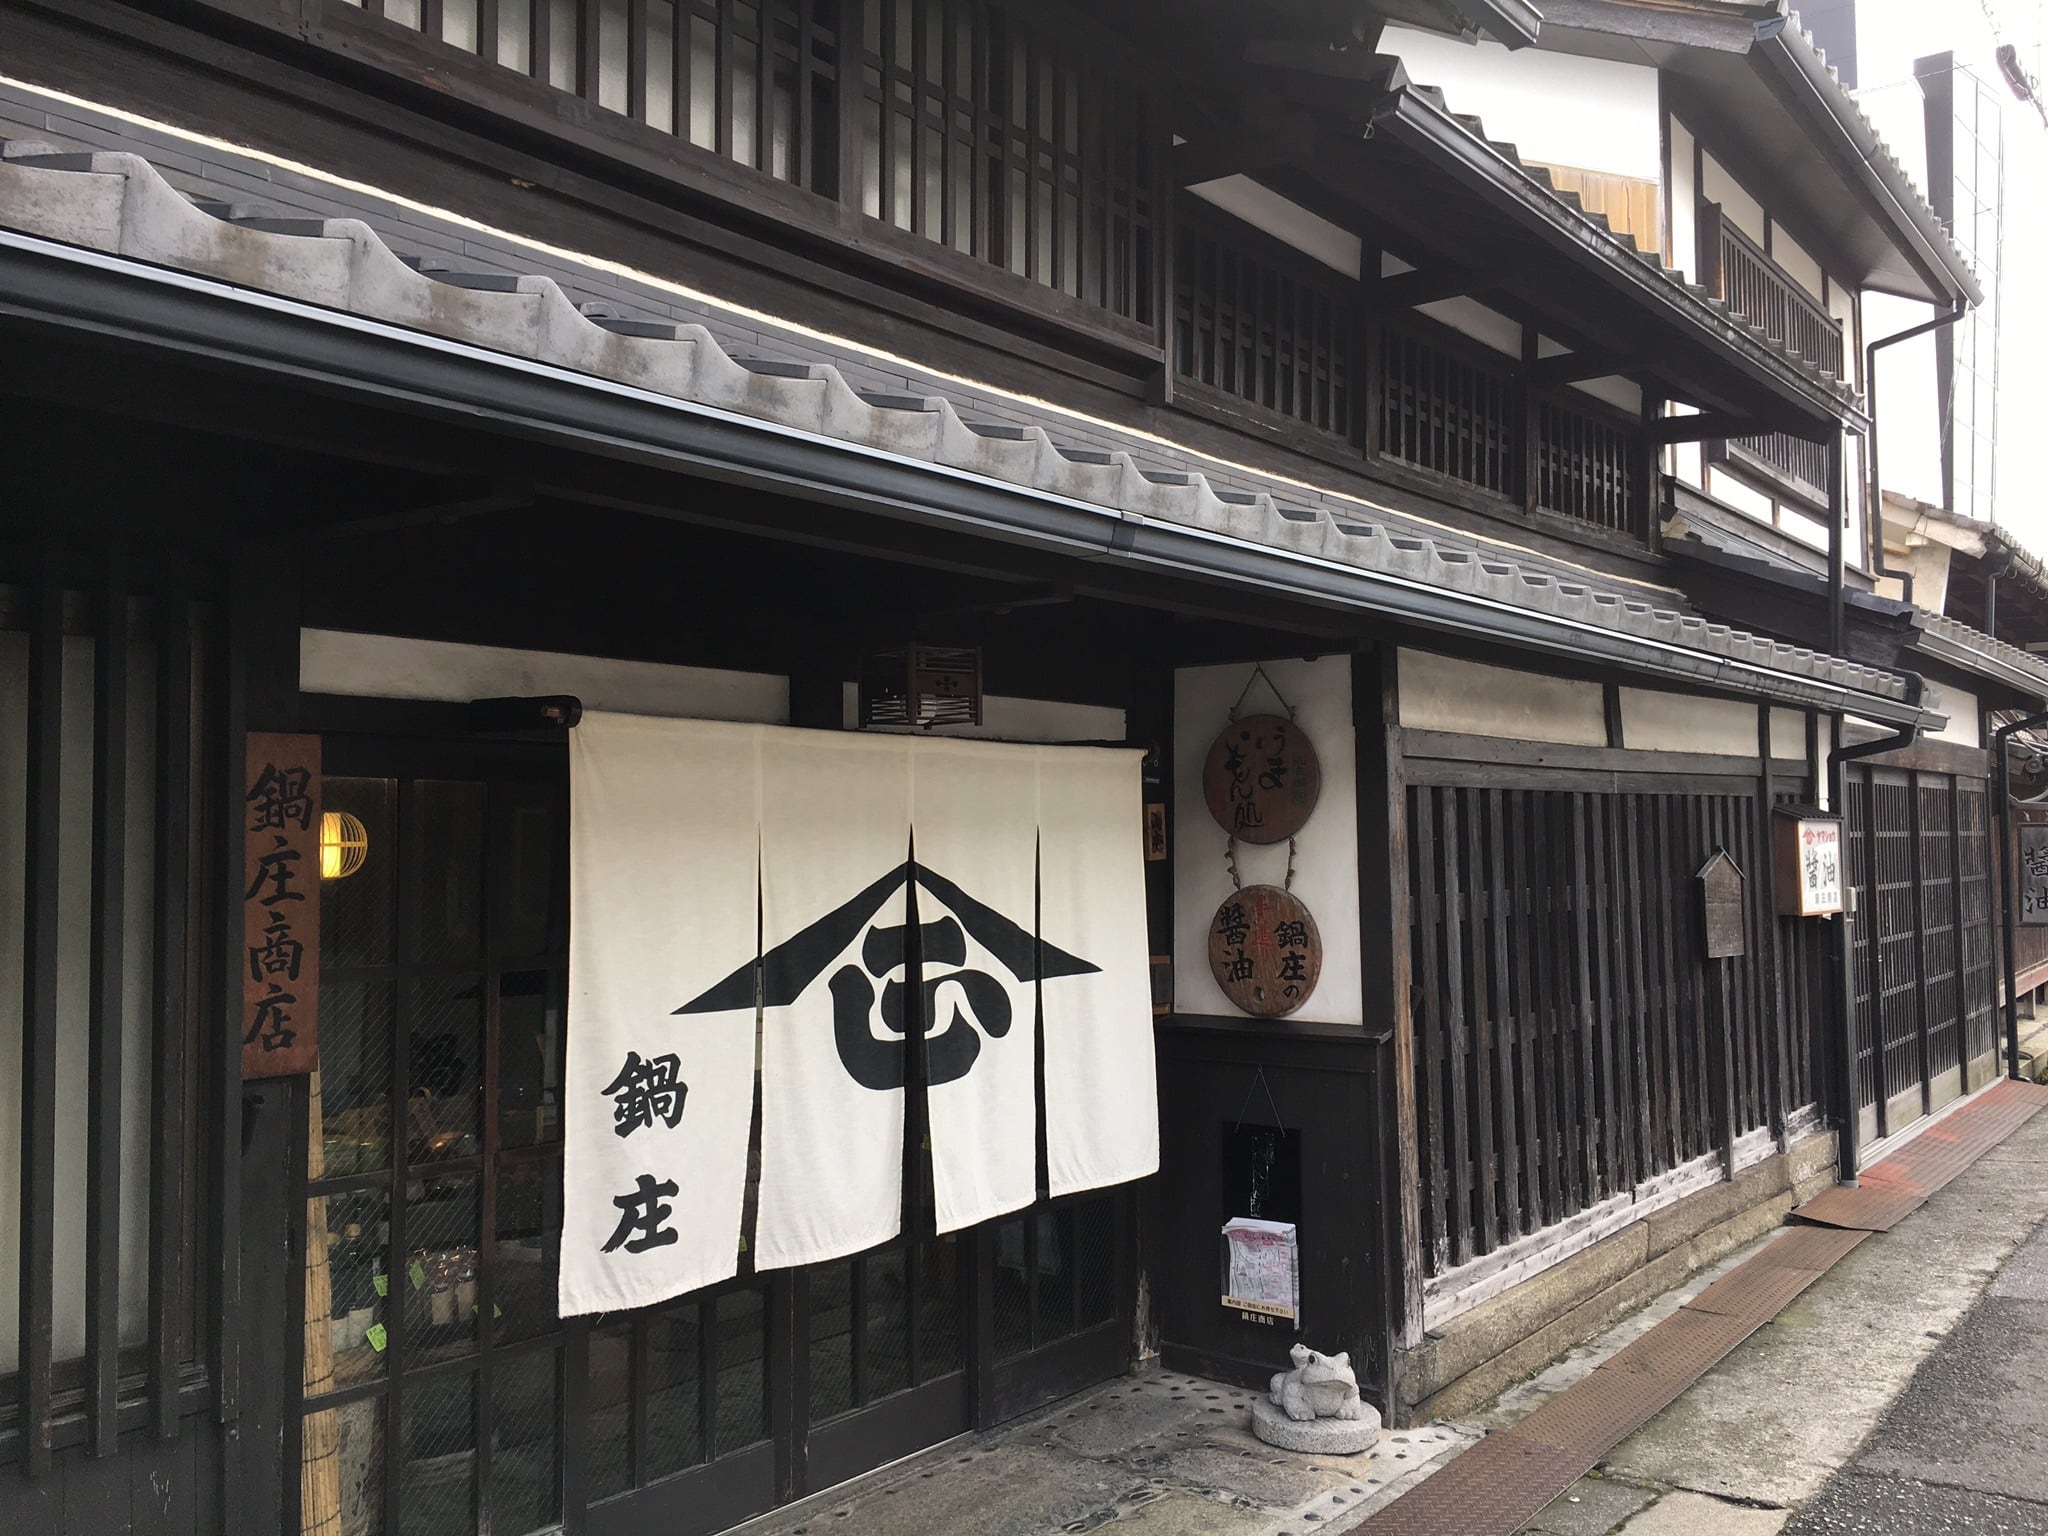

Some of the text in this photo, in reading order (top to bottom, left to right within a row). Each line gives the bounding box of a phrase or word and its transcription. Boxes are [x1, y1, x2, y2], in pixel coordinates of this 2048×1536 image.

[244, 761, 313, 1053] 鍋庄商店
[1273, 919, 1309, 1000] 鍋庄の
[600, 1050, 689, 1255] 鍋庄
